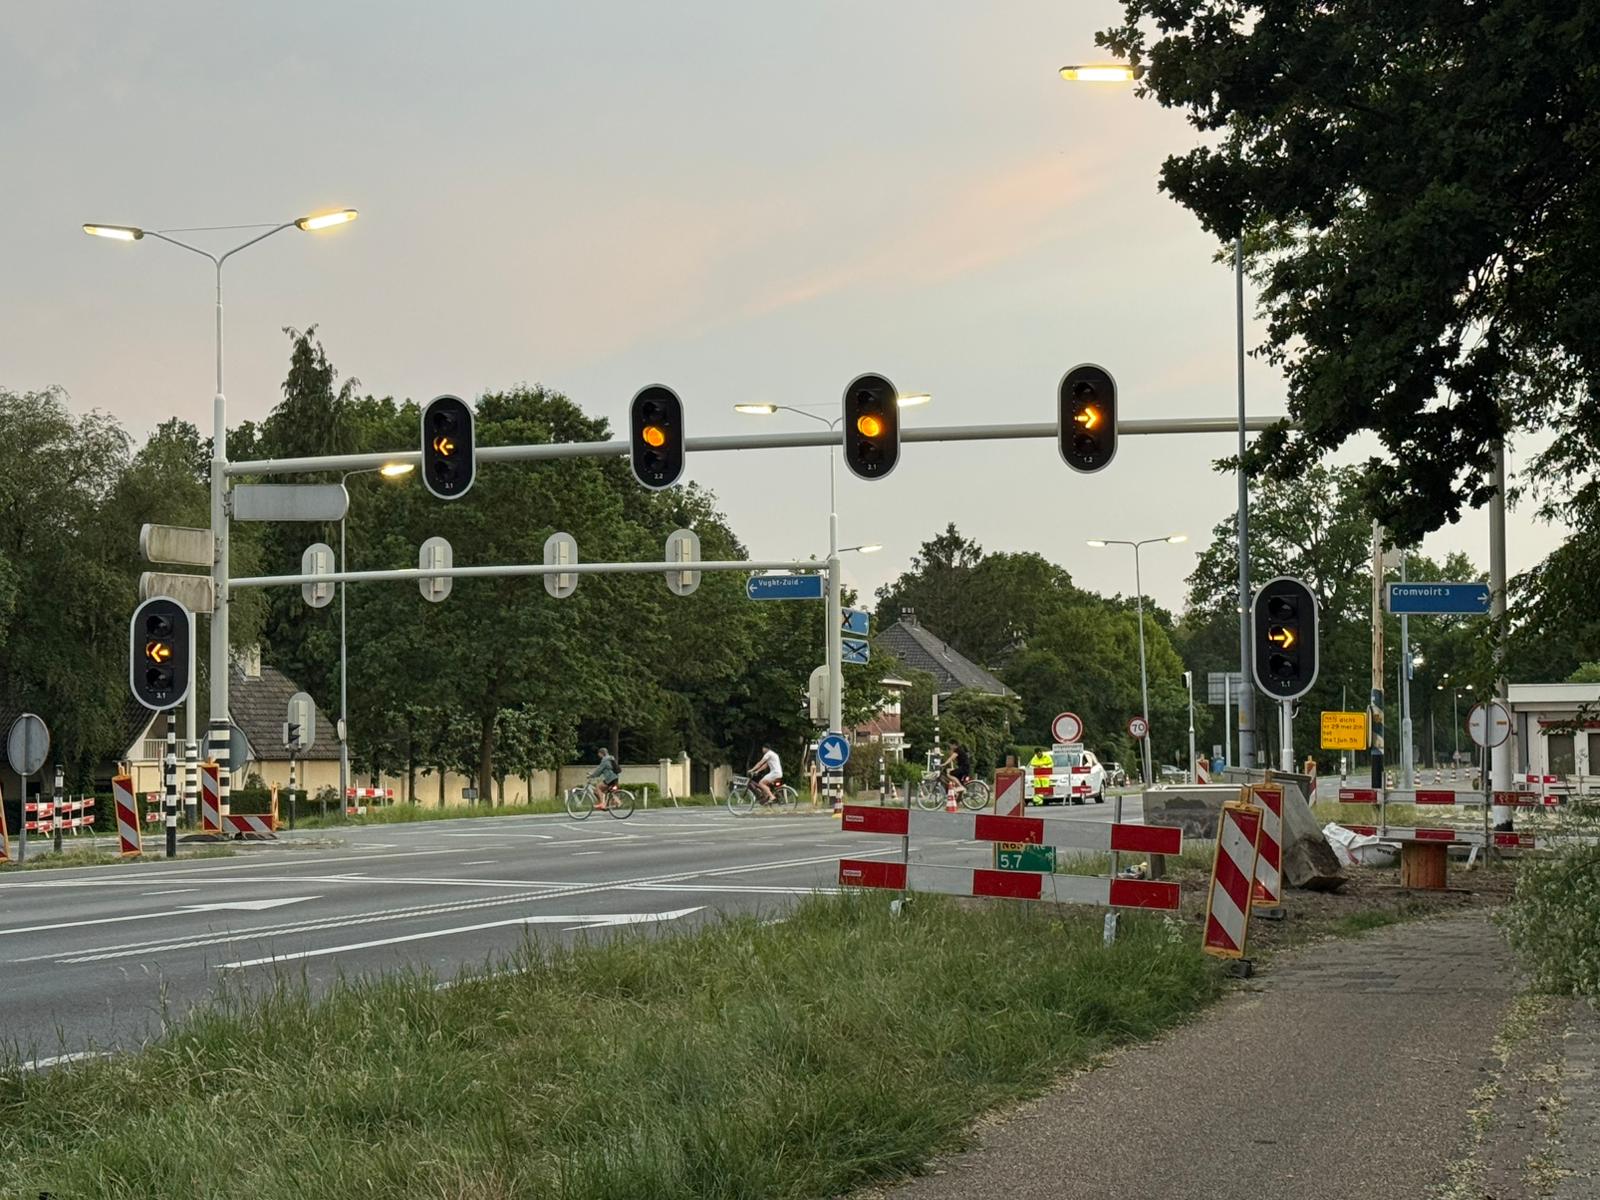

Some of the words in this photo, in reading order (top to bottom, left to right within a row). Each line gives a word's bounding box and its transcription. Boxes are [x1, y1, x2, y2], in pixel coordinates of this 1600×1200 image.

[758, 579, 799, 588] Vught-Zuid
[1392, 587, 1442, 596] Cromvoirt
[1444, 588, 1450, 596] 3
[1132, 722, 1145, 733] 70
[1000, 854, 1023, 869] 5.7
